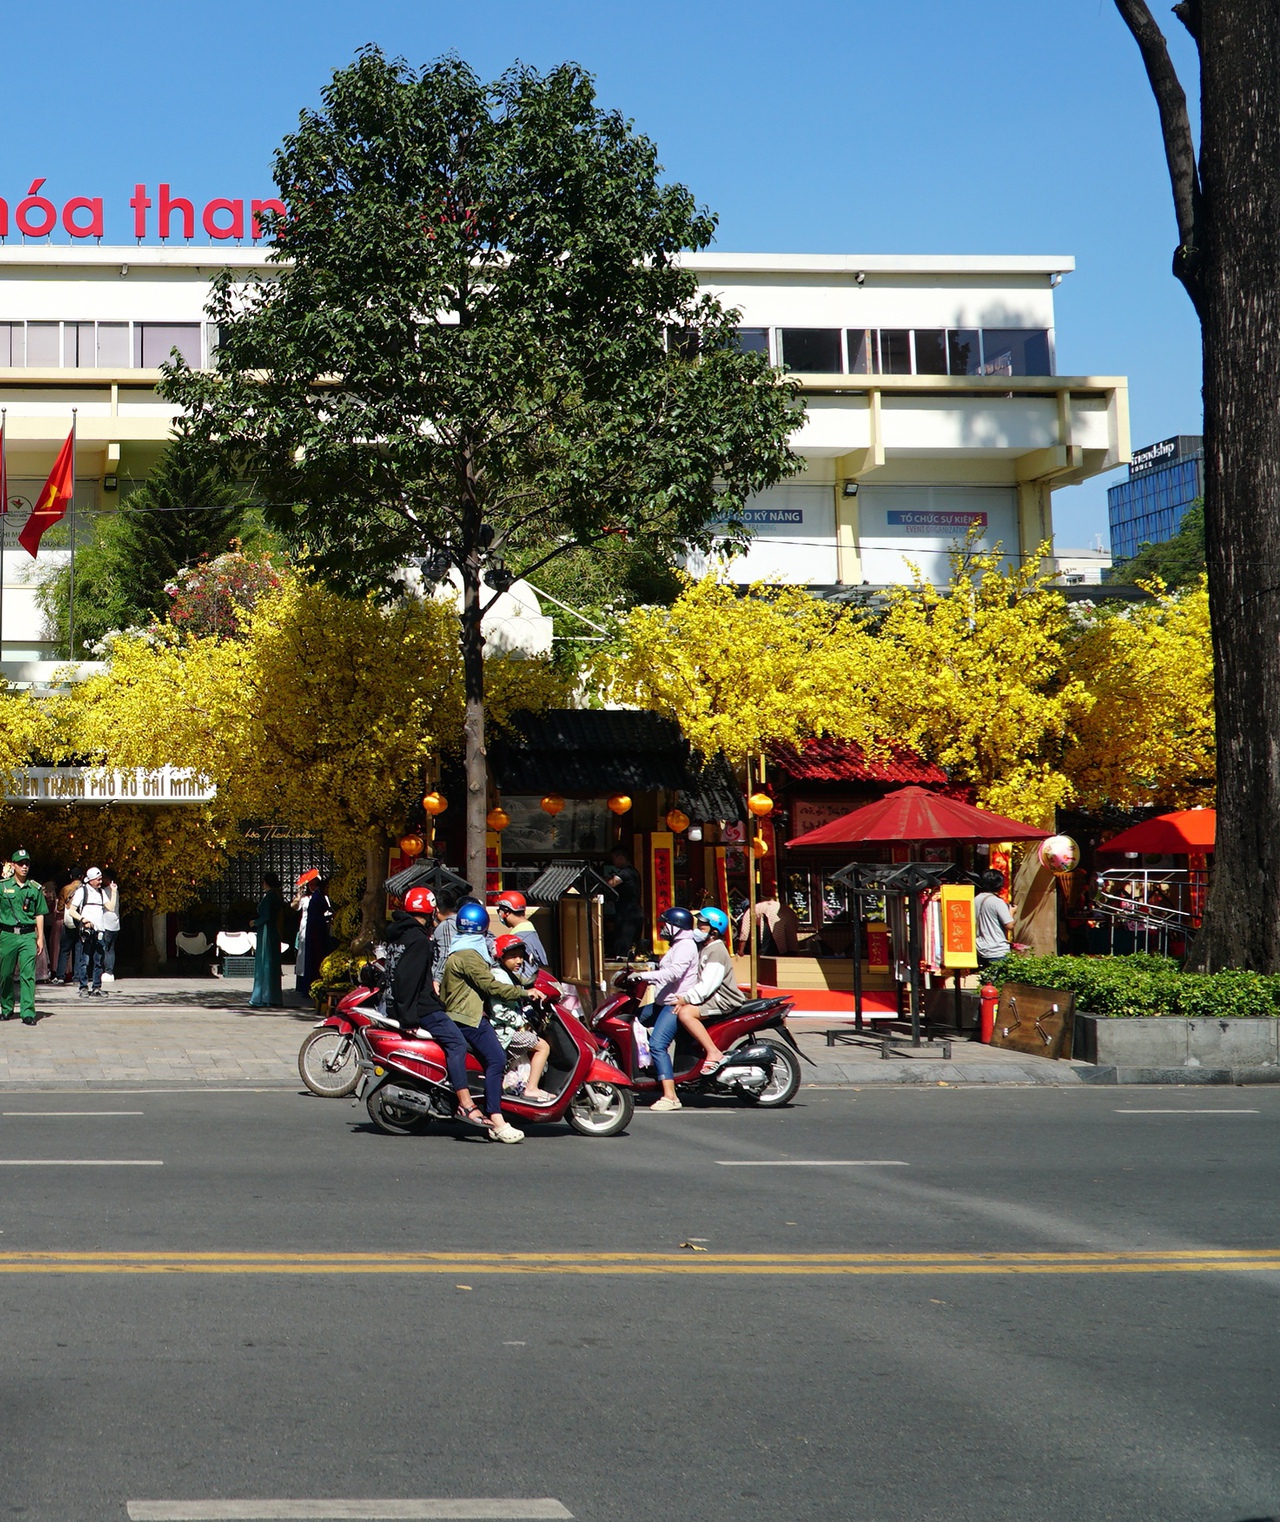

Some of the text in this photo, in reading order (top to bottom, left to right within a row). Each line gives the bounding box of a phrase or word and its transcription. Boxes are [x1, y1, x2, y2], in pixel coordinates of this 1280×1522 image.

[769, 510, 800, 521] NĂNG
[900, 512, 912, 523] TỔ
[914, 513, 936, 523] CHỨC
[906, 525, 925, 533] EVENT
